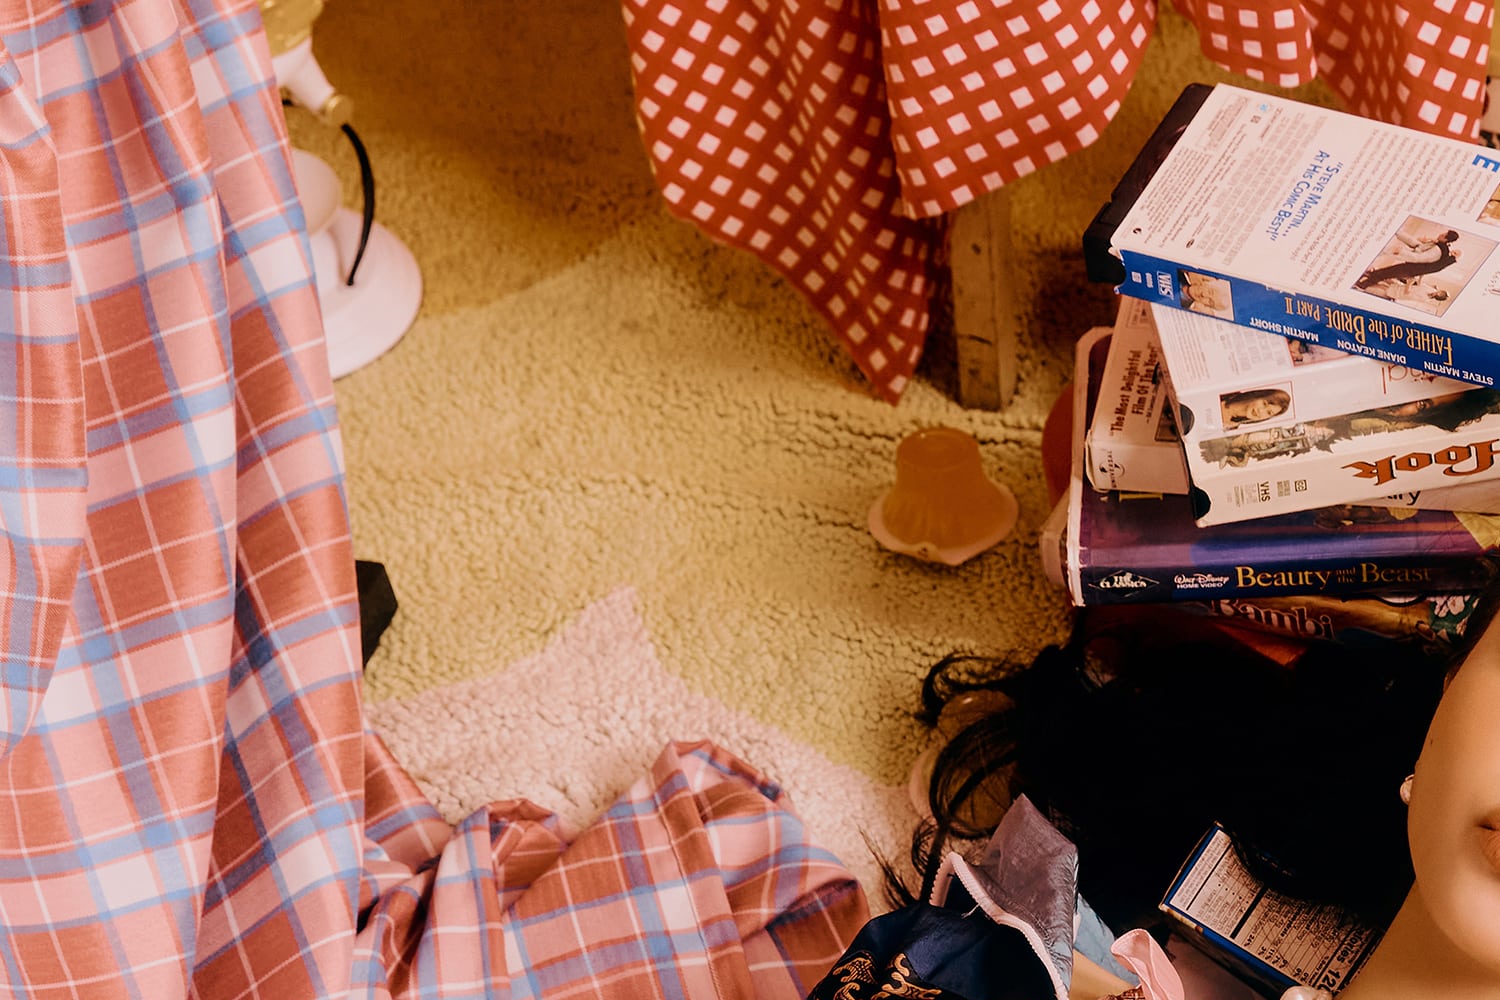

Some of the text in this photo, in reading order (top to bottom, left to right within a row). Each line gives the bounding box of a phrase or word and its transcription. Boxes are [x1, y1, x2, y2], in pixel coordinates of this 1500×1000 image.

[1282, 180, 1310, 209] COMIC
[1296, 299, 1320, 321] PART
[1250, 317, 1320, 342] MARTIN SHORT
[1325, 306, 1366, 345] BRIDE
[1368, 318, 1388, 339] the
[1390, 324, 1403, 344] of
[1337, 339, 1407, 365] DIANE KEATON
[1406, 327, 1453, 366] FATHER
[1120, 350, 1142, 392] Delightful
[1140, 369, 1154, 382] The
[1423, 361, 1494, 386] STEVE MARTIN
[1136, 384, 1150, 394] Of
[1114, 395, 1130, 416] Most
[1131, 397, 1146, 415] Film
[1260, 481, 1270, 502] VHS
[1235, 566, 1331, 590] Beauty
[1360, 562, 1432, 583] Beast
